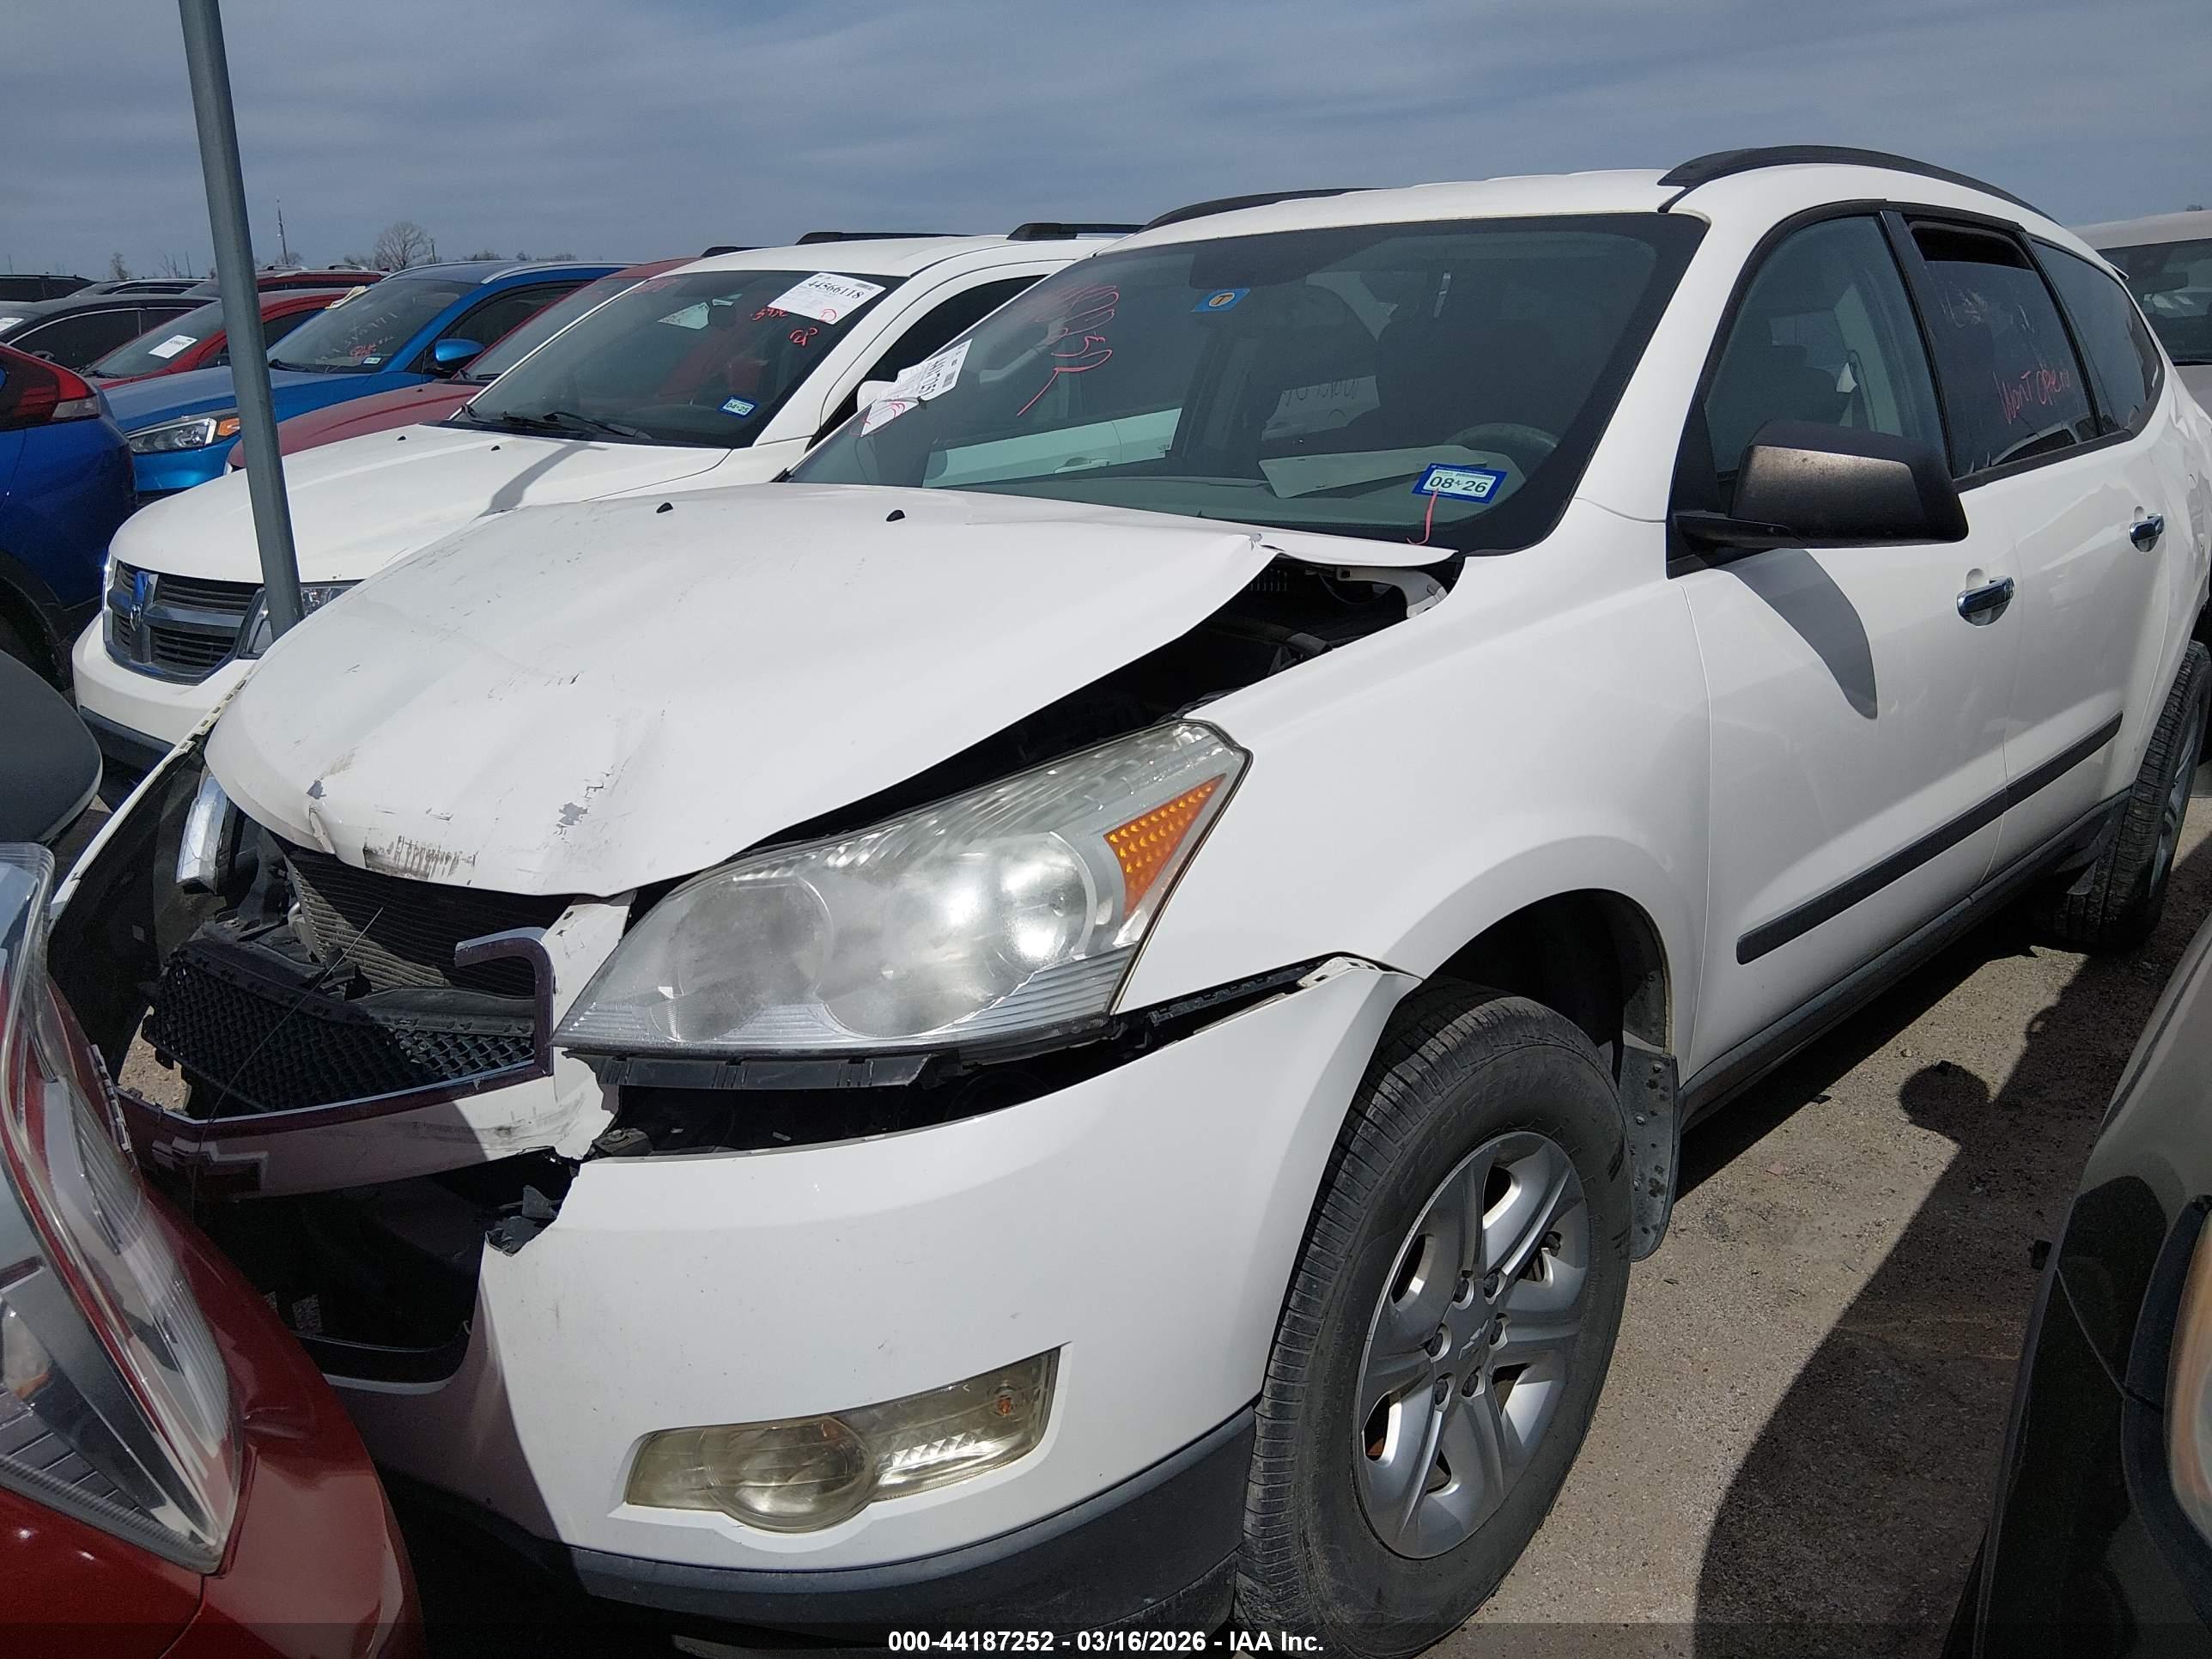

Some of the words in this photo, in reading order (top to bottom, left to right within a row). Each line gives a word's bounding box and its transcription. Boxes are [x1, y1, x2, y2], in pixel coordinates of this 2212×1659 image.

[808, 280, 865, 300] 44566118
[1429, 476, 1455, 489] 08
[1462, 480, 1488, 493] 26
